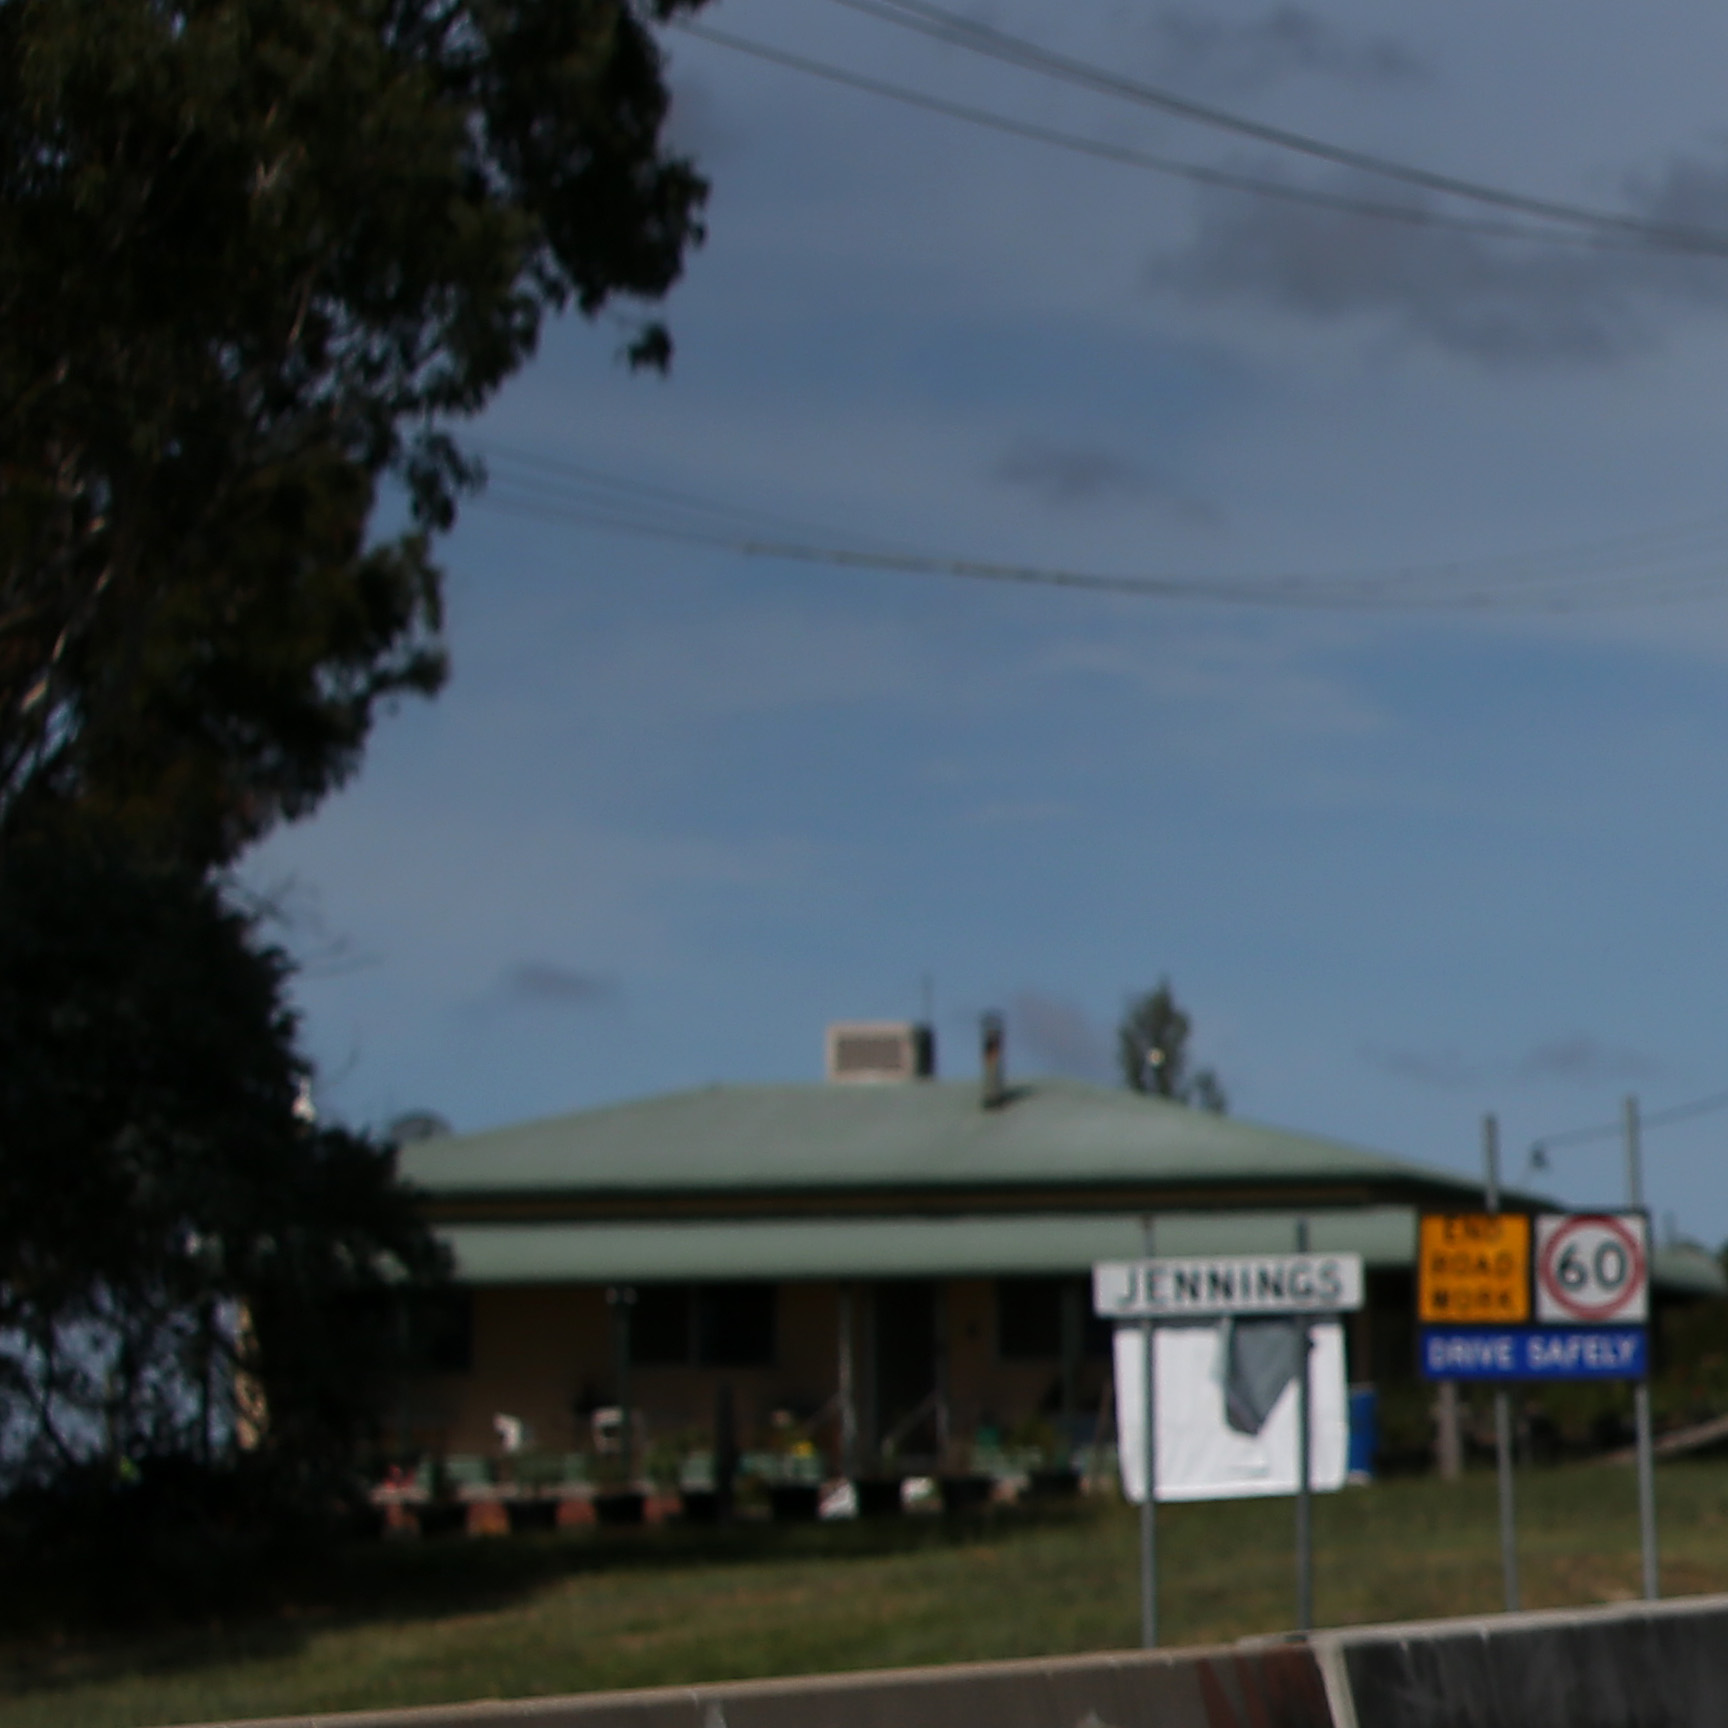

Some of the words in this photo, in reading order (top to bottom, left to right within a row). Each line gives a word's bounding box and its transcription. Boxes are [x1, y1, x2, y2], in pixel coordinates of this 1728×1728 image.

[1431, 1250, 1513, 1278] ROAD
[1557, 1240, 1627, 1291] 60
[1116, 1261, 1342, 1306] JENNINGS
[1431, 1288, 1513, 1312] WORK
[1427, 1335, 1513, 1371] DRIVE
[1526, 1334, 1638, 1370] SAFELY
